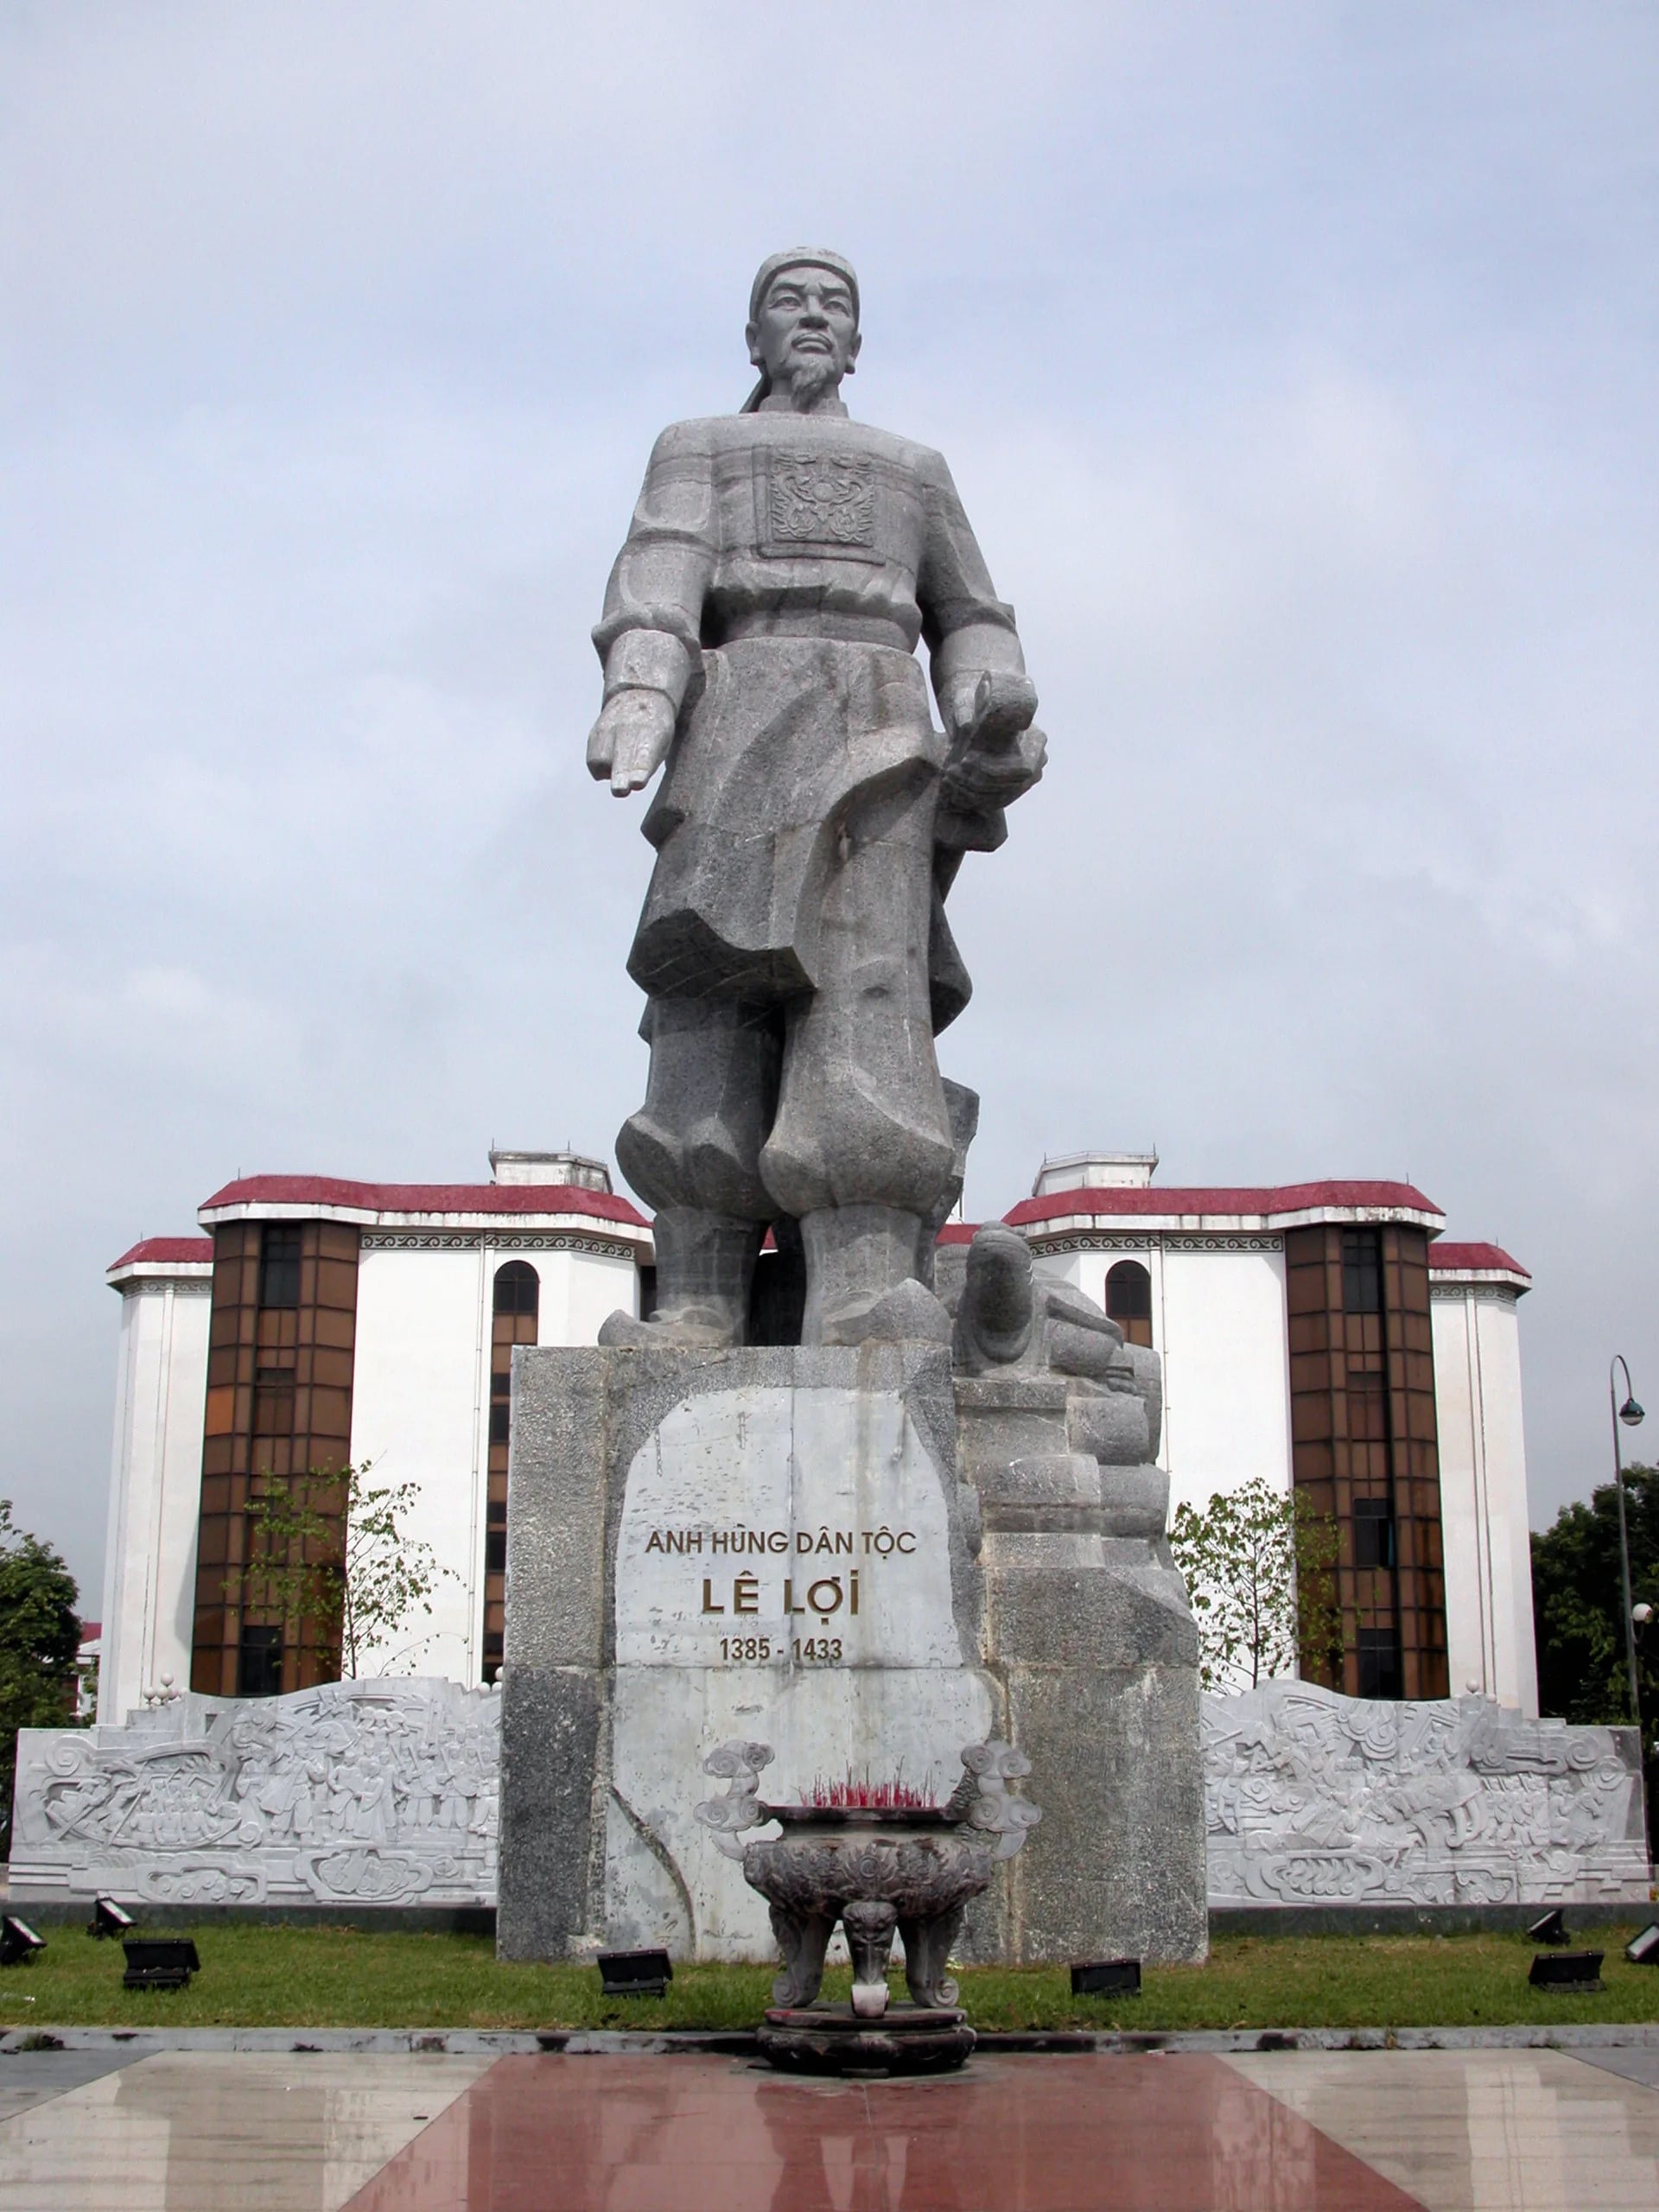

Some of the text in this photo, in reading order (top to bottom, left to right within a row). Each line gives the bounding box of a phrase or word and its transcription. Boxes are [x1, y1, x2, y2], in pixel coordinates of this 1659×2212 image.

[645, 1531, 702, 1554] ANH
[796, 1526, 854, 1554] DÂN
[861, 1526, 917, 1560] TỘC
[701, 1570, 760, 1616] LÊ
[720, 1638, 770, 1660] 1385
[793, 1638, 842, 1660] 1433
